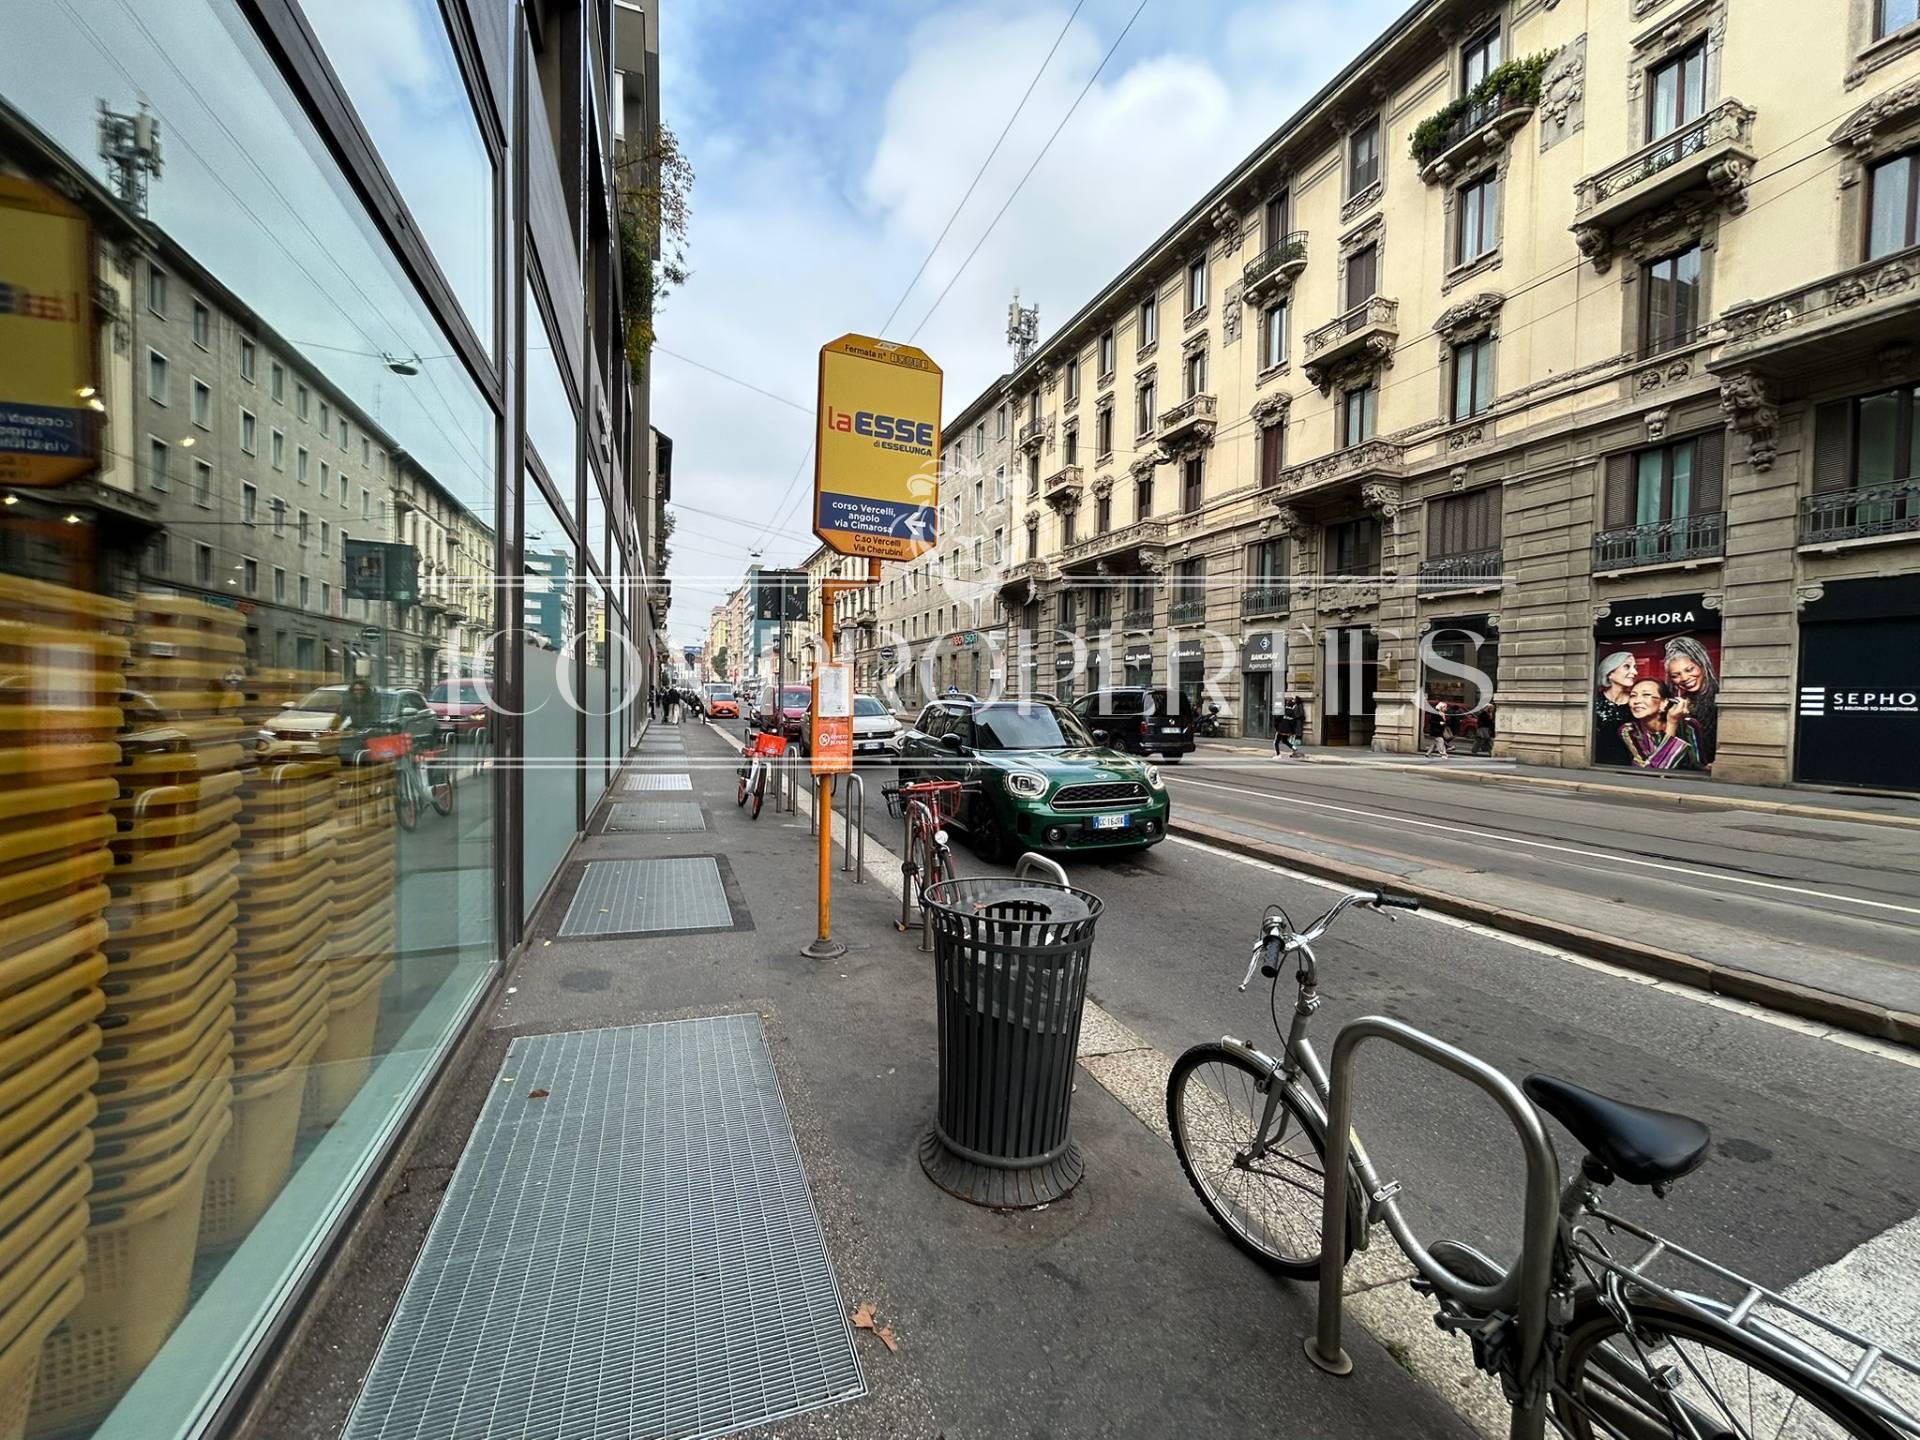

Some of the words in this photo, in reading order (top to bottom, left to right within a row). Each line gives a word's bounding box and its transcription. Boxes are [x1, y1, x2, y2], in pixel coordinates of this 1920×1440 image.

[845, 344, 876, 357] Fermata
[881, 441, 932, 457] ESSELUNGA
[832, 501, 858, 511] corso
[860, 504, 896, 517] Vercelli,
[848, 512, 880, 523] angolo
[834, 519, 848, 528] via
[850, 520, 893, 533] Cimarosa
[854, 534, 871, 544] C.so
[872, 536, 901, 547] Vercelli
[853, 544, 866, 553] Via
[867, 545, 903, 557] Cherubini
[1614, 611, 1695, 627] SEPHORA
[1833, 693, 1917, 705] SEPHO
